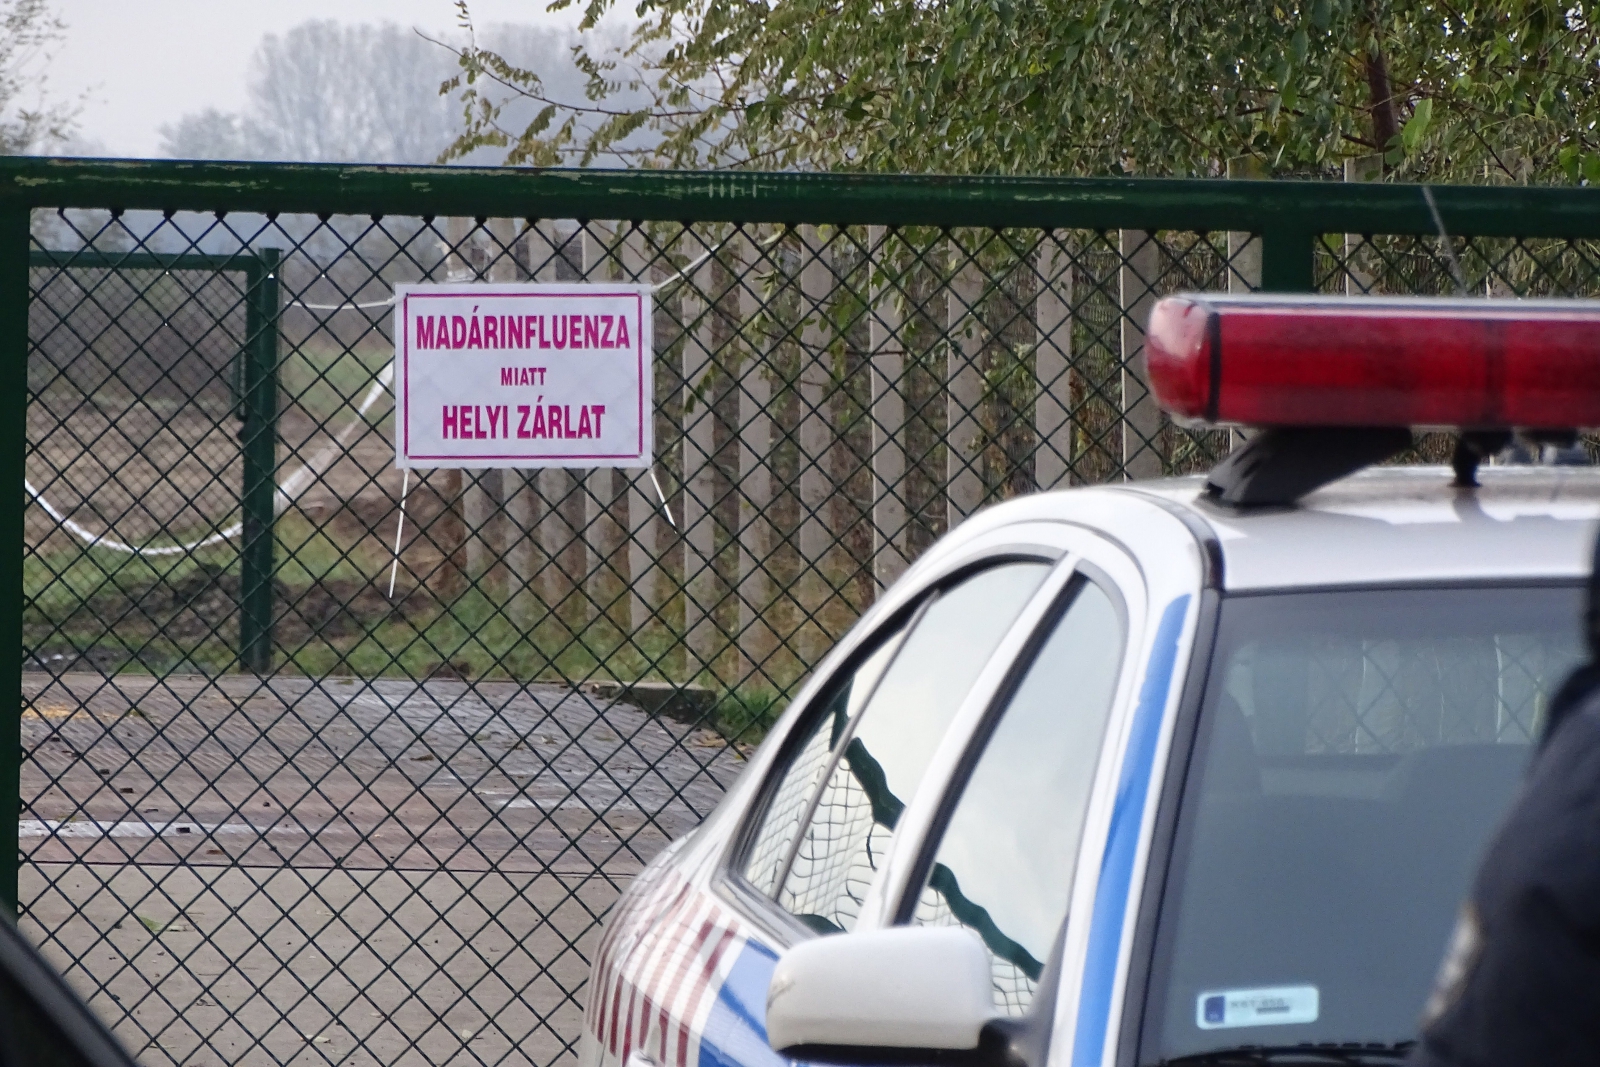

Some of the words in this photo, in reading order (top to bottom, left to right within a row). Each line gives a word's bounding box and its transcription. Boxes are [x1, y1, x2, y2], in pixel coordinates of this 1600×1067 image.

[416, 305, 630, 350] MADÁRINFLUENZA
[501, 367, 547, 386] MIATT
[442, 405, 509, 439] HELYI
[516, 395, 606, 439] ZÁRLAT
